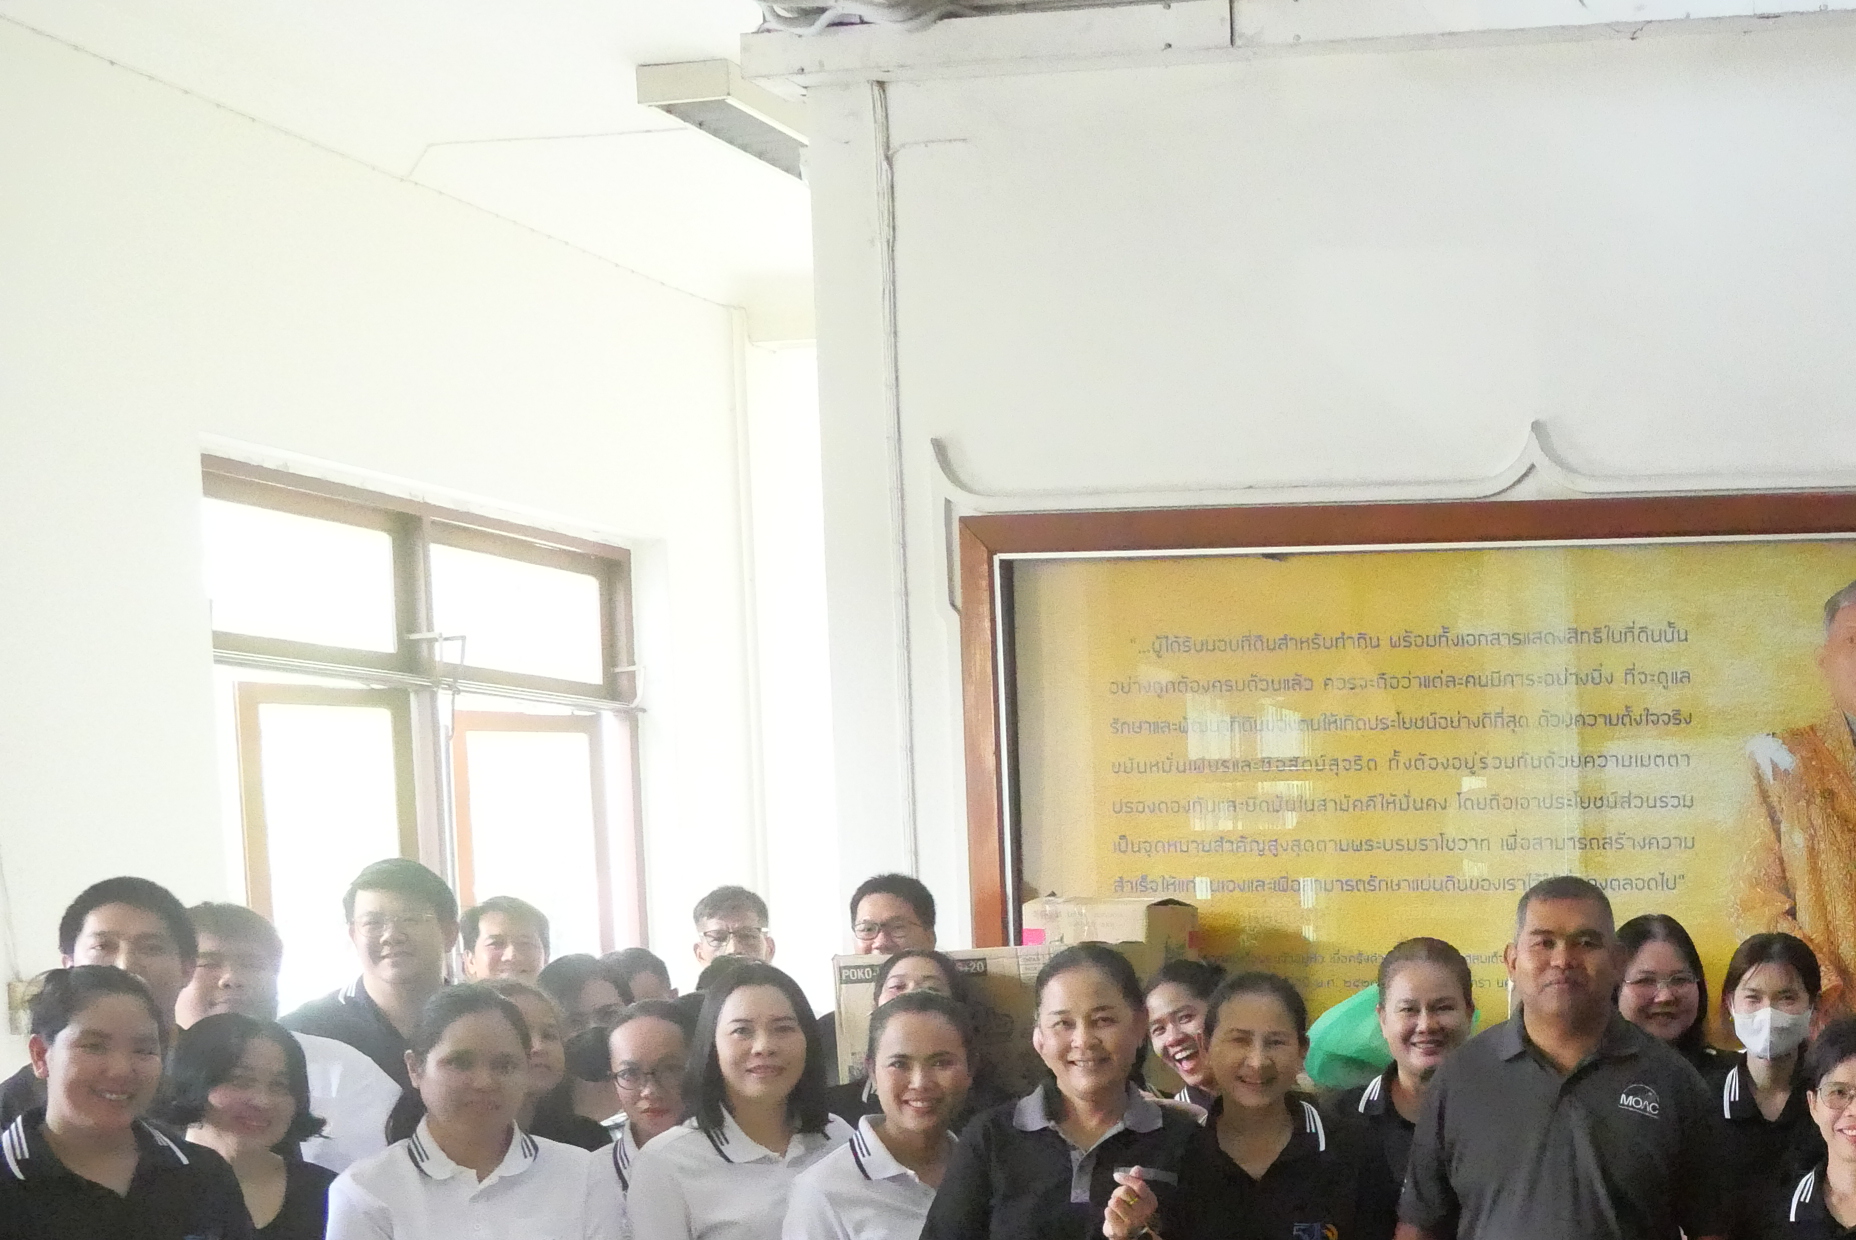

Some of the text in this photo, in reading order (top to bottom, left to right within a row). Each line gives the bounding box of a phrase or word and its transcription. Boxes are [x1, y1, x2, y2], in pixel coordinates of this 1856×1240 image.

[1624, 662, 1691, 690] ที่จะดูแล
[1620, 1093, 1659, 1114] MOAC
